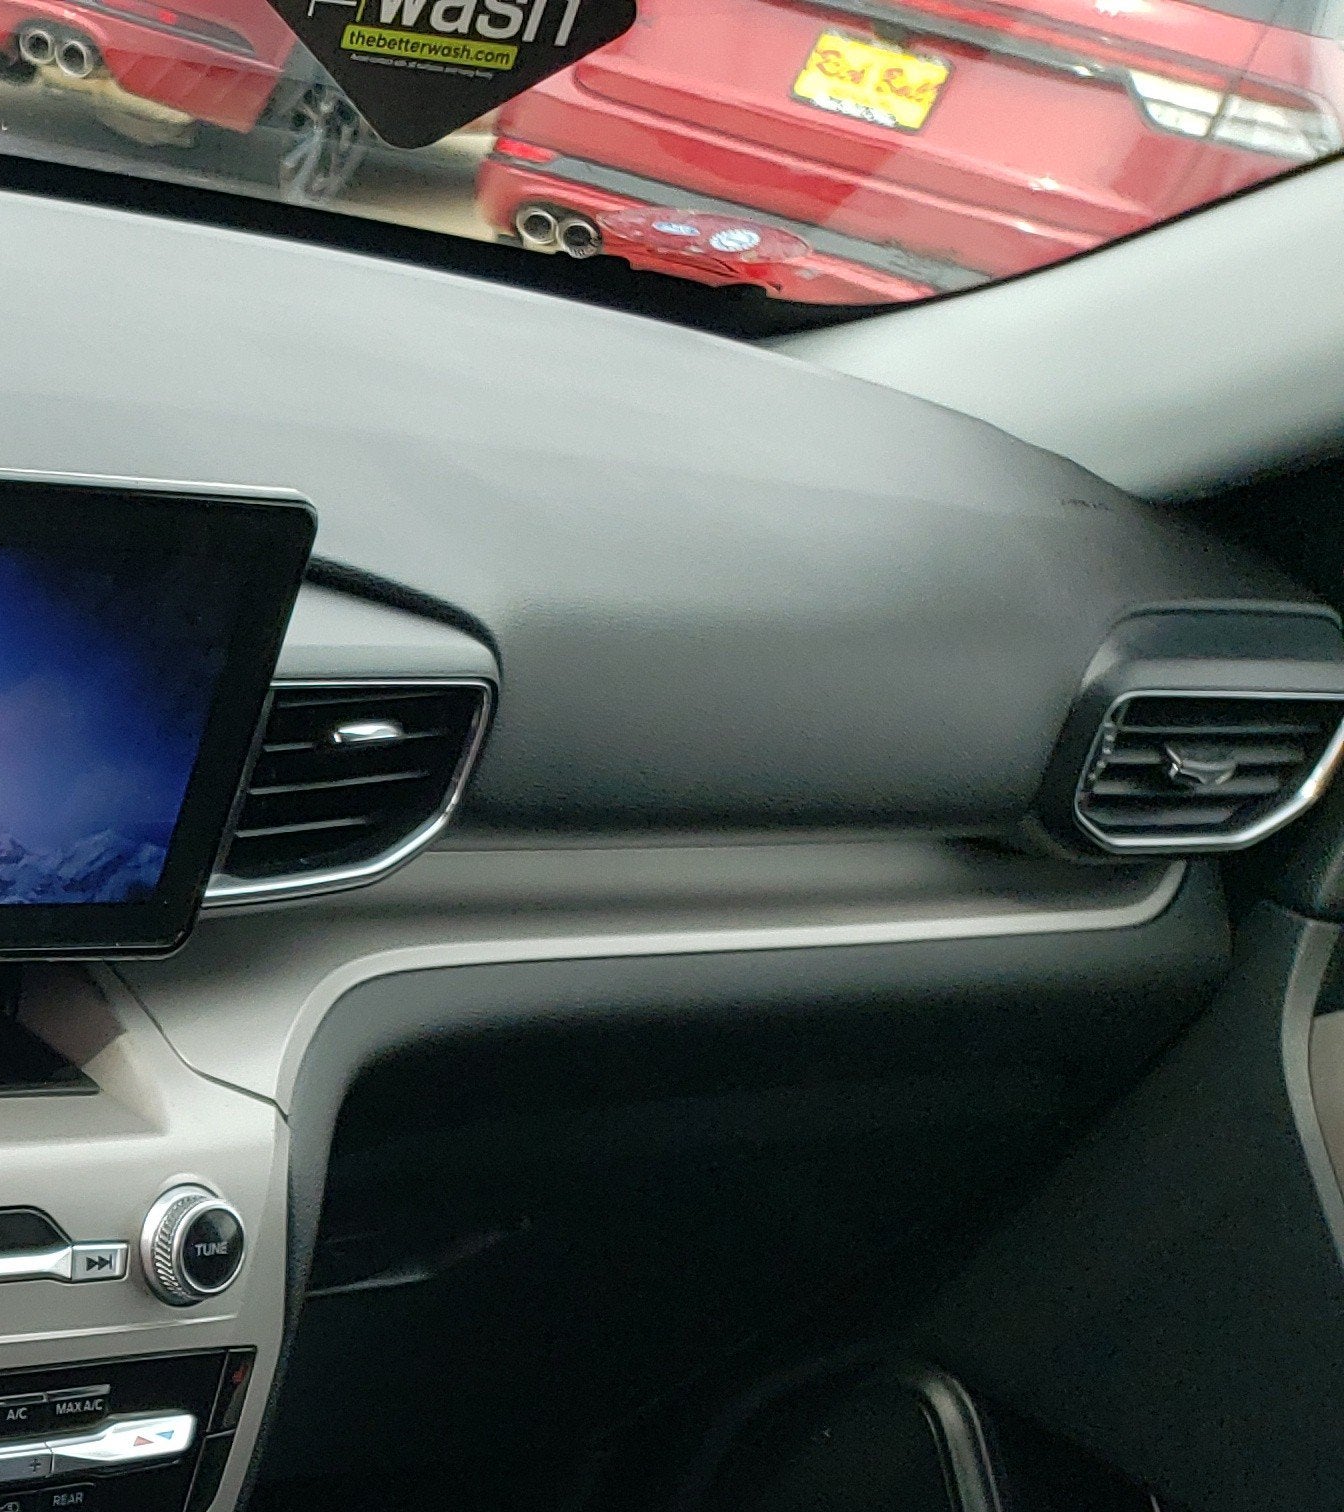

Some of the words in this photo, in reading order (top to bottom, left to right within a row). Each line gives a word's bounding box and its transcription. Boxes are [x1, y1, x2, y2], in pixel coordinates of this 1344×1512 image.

[348, 30, 512, 65] thebetterwash.com
[194, 1241, 229, 1257] TUNE
[6, 1406, 28, 1421] A/C
[55, 1402, 81, 1416] MAX
[82, 1397, 103, 1412] A/C
[53, 1491, 84, 1507] REAR
